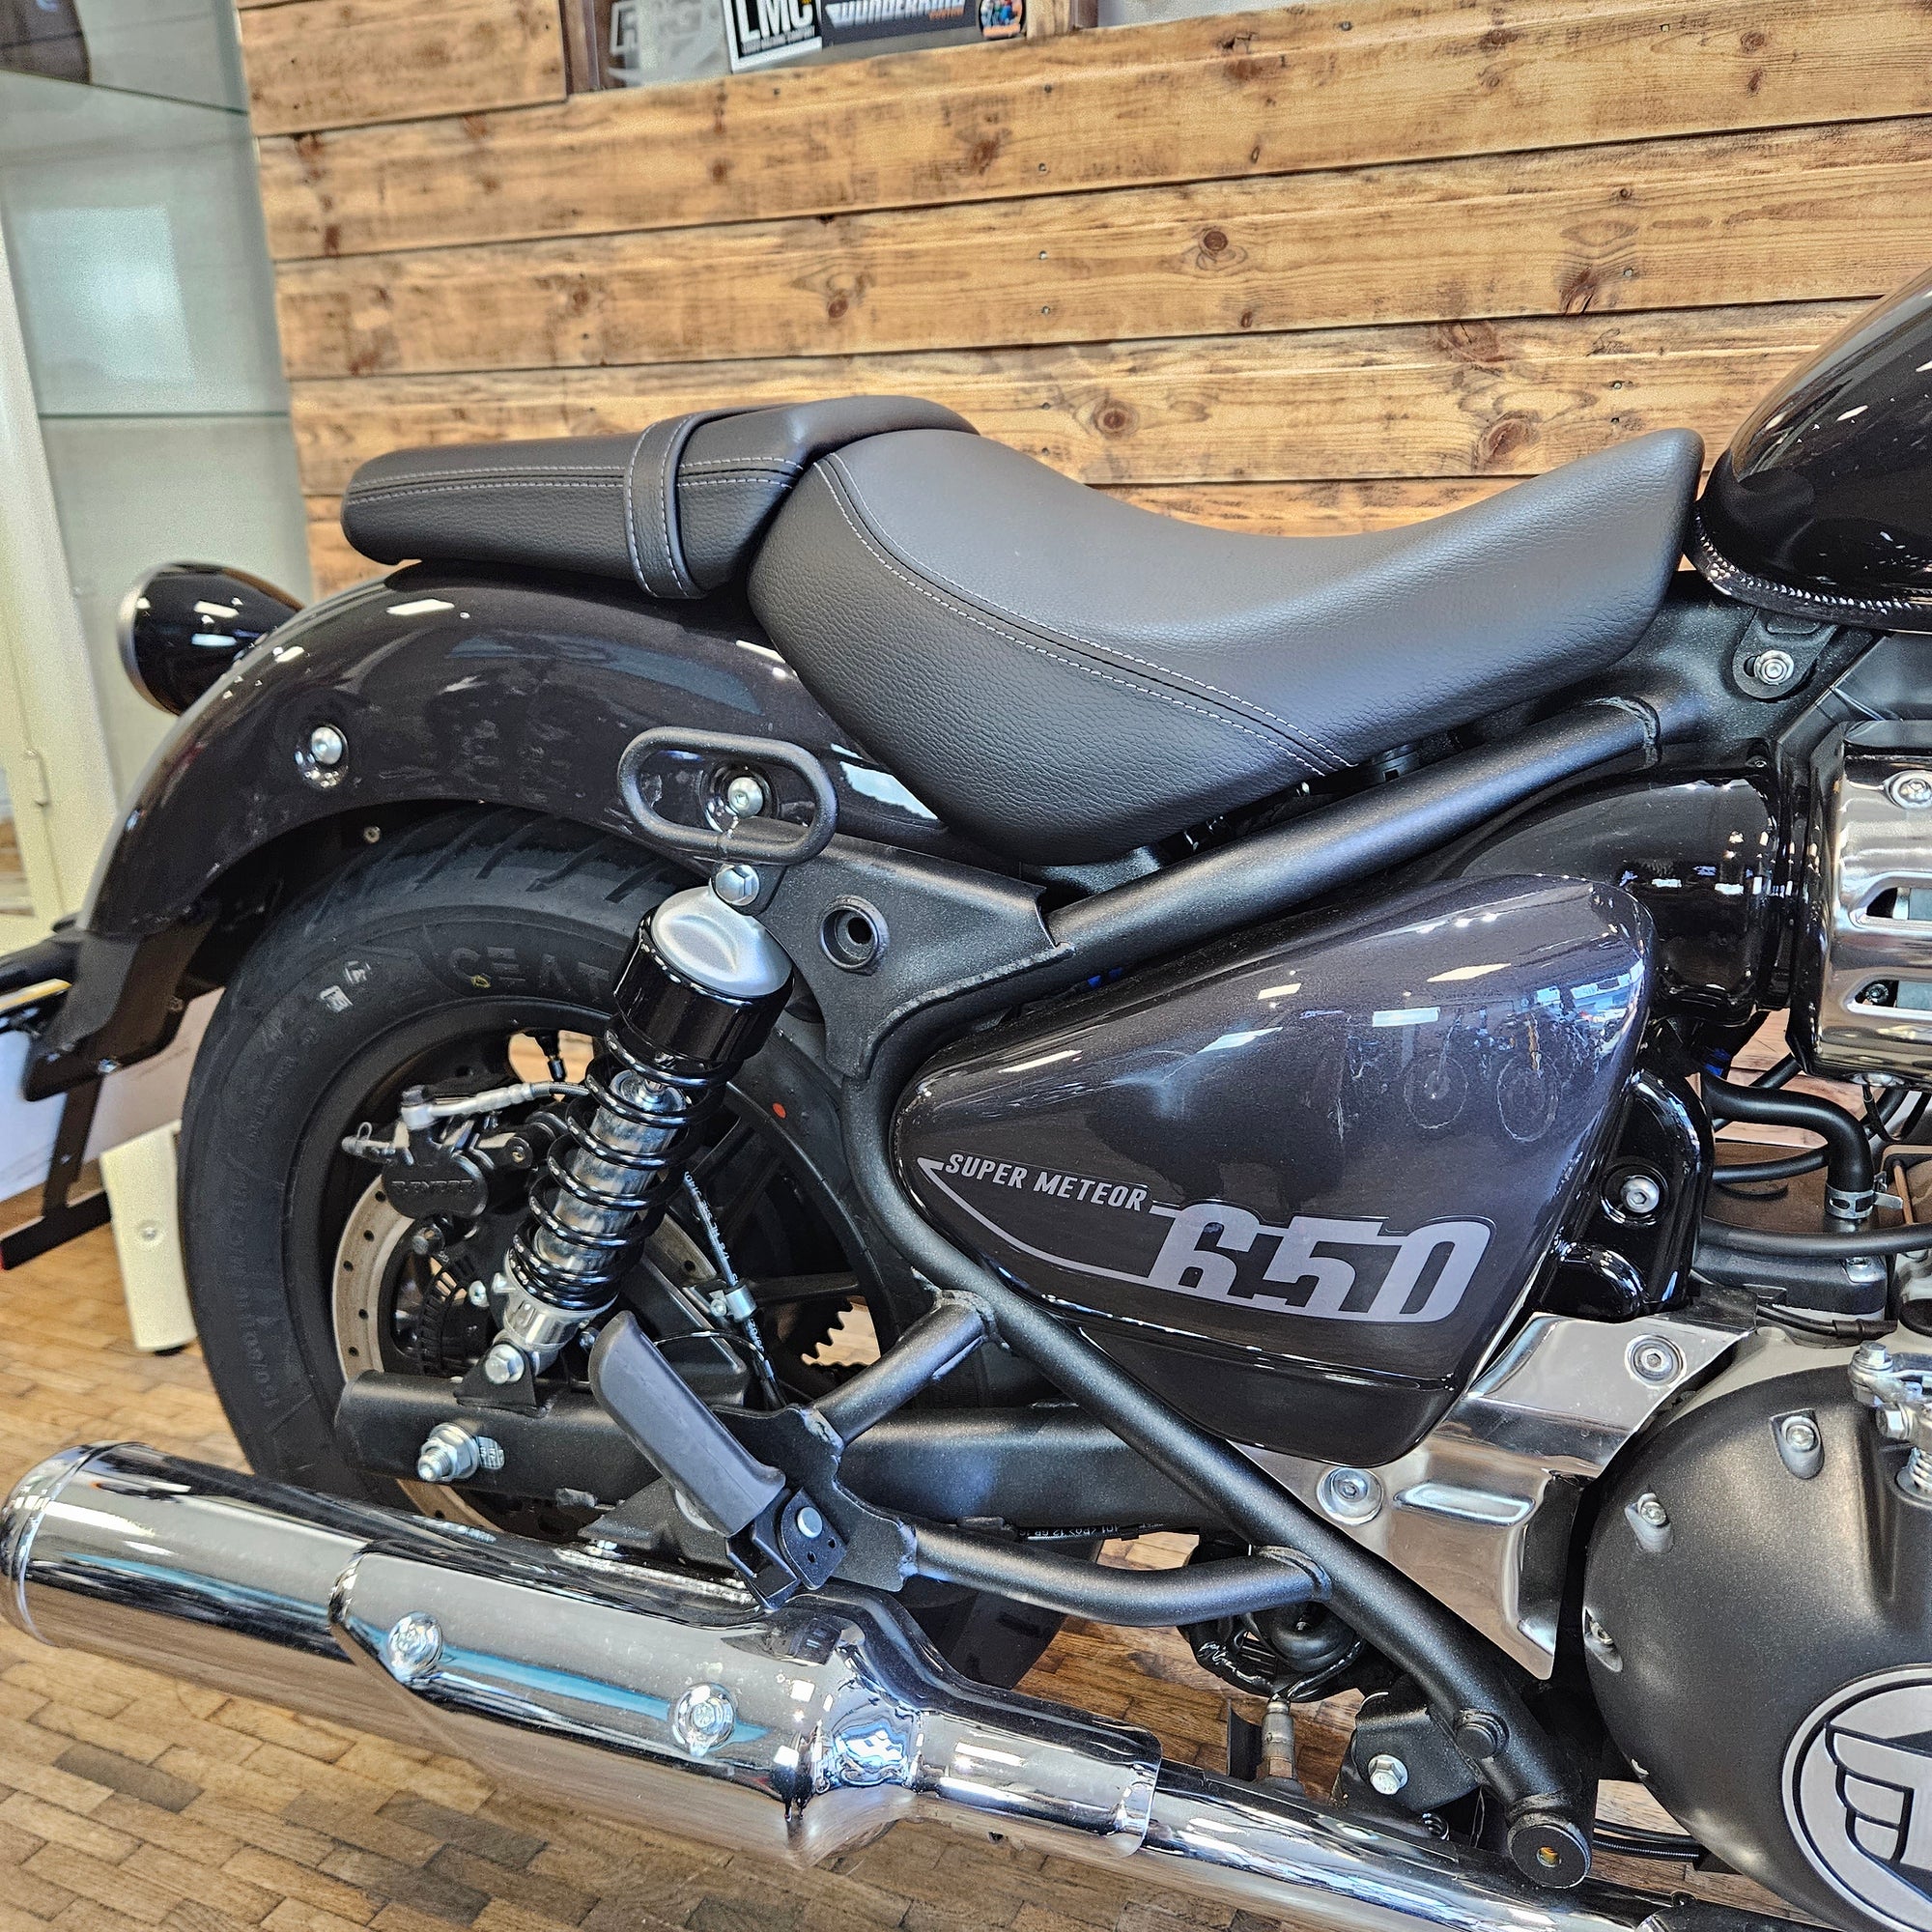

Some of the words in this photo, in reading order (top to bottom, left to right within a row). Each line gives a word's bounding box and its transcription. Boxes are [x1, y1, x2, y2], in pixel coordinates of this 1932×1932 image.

[736, 0, 813, 43] LMC
[447, 946, 611, 1004] CEAT
[945, 1153, 1029, 1189] SUPER
[1033, 1171, 1149, 1212] METEOR
[1148, 1202, 1496, 1324] 650
